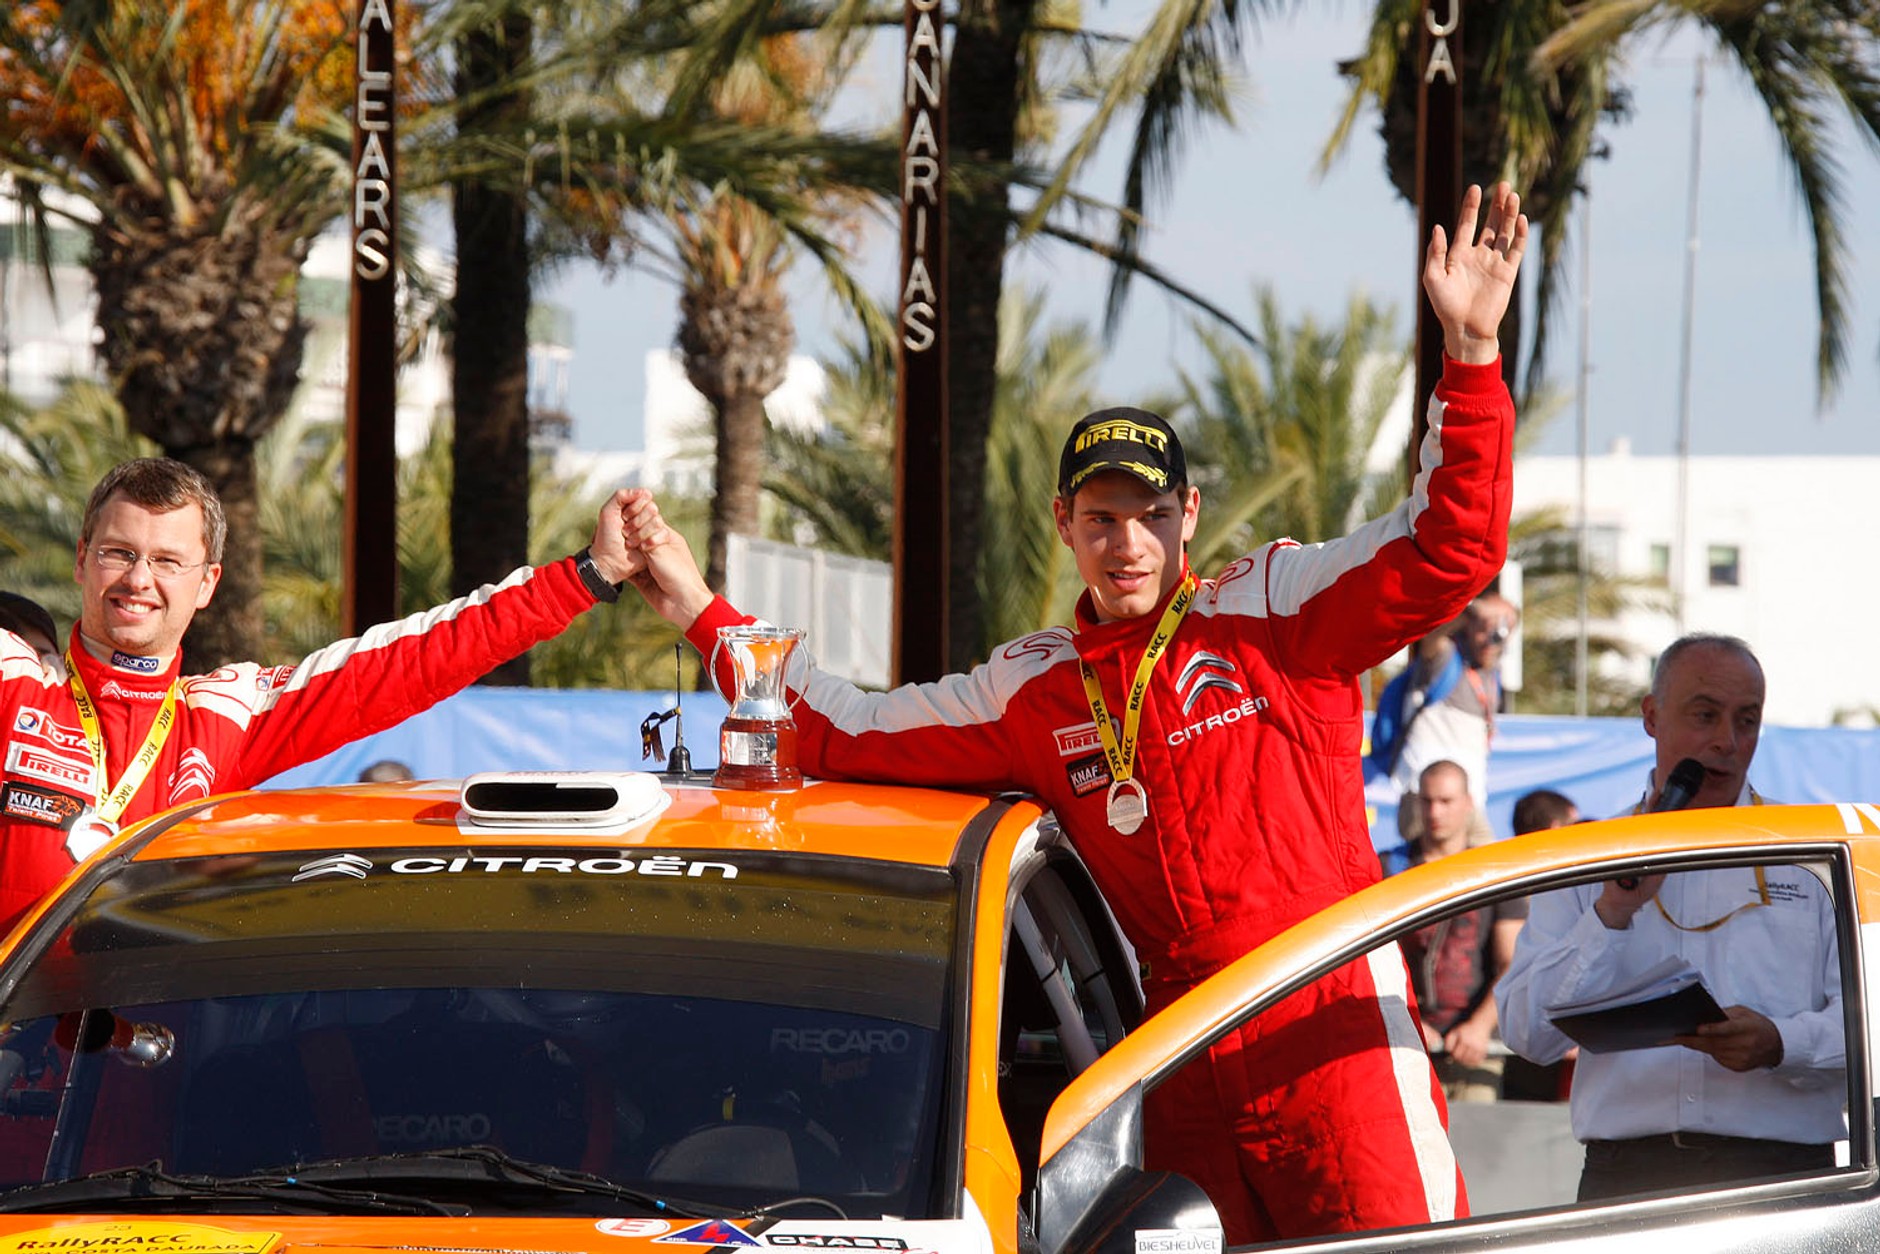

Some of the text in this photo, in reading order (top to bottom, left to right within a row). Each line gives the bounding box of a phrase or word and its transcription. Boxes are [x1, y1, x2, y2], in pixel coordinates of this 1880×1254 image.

[904, 0, 940, 351] ANARIAS
[1075, 419, 1168, 453] PIRELLI
[1147, 632, 1167, 659] RACC
[113, 652, 157, 669] sparco
[1130, 682, 1144, 711] RACC
[1092, 700, 1106, 728] RACC
[45, 719, 90, 750] TOTA
[20, 750, 91, 784] PIRELLI
[1108, 747, 1122, 775] RACC
[1070, 765, 1098, 787] KNAF
[9, 790, 54, 811] KNAF
[770, 1028, 909, 1054] RECARO
[371, 1113, 491, 1142] ECARO
[17, 1234, 191, 1249] RallyRACC
